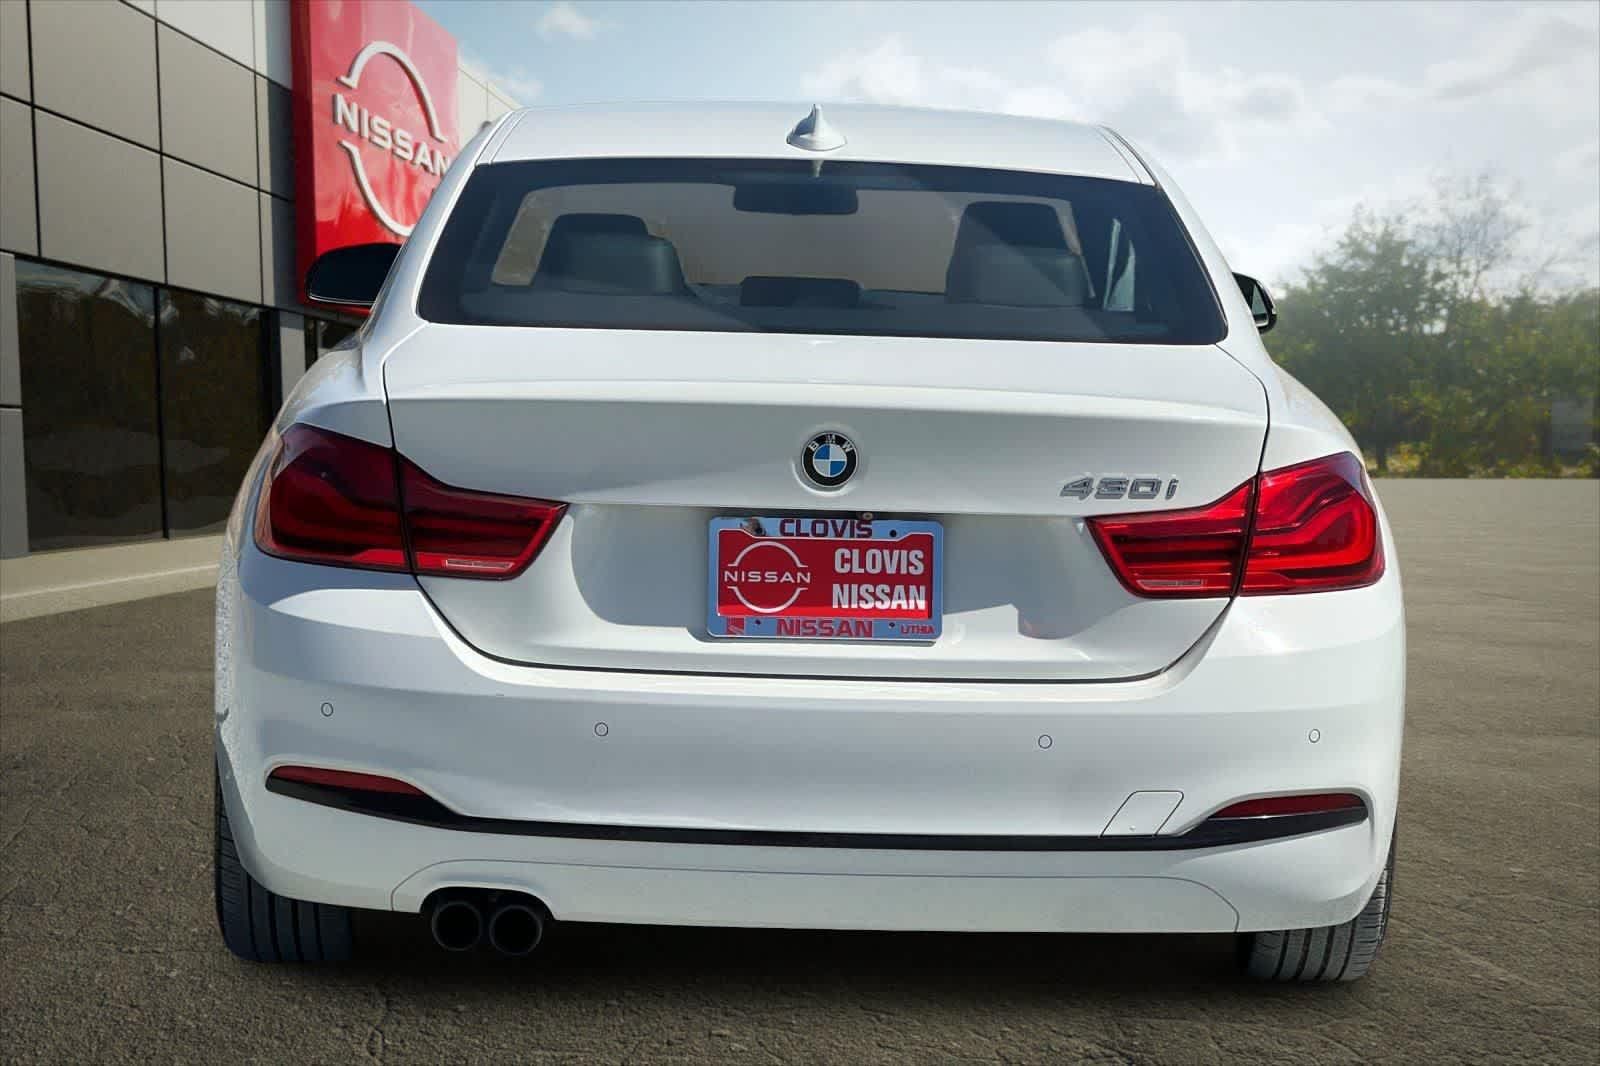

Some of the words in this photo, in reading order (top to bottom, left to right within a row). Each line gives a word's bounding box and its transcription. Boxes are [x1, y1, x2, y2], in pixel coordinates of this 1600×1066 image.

[333, 94, 448, 177] NISSAN
[808, 433, 854, 451] BMW
[779, 518, 873, 538] CLOVIS
[834, 548, 924, 575] CLOVIS
[723, 571, 811, 583] NISSAN
[832, 583, 926, 610] NISSAN
[776, 618, 873, 637] NISSAN
